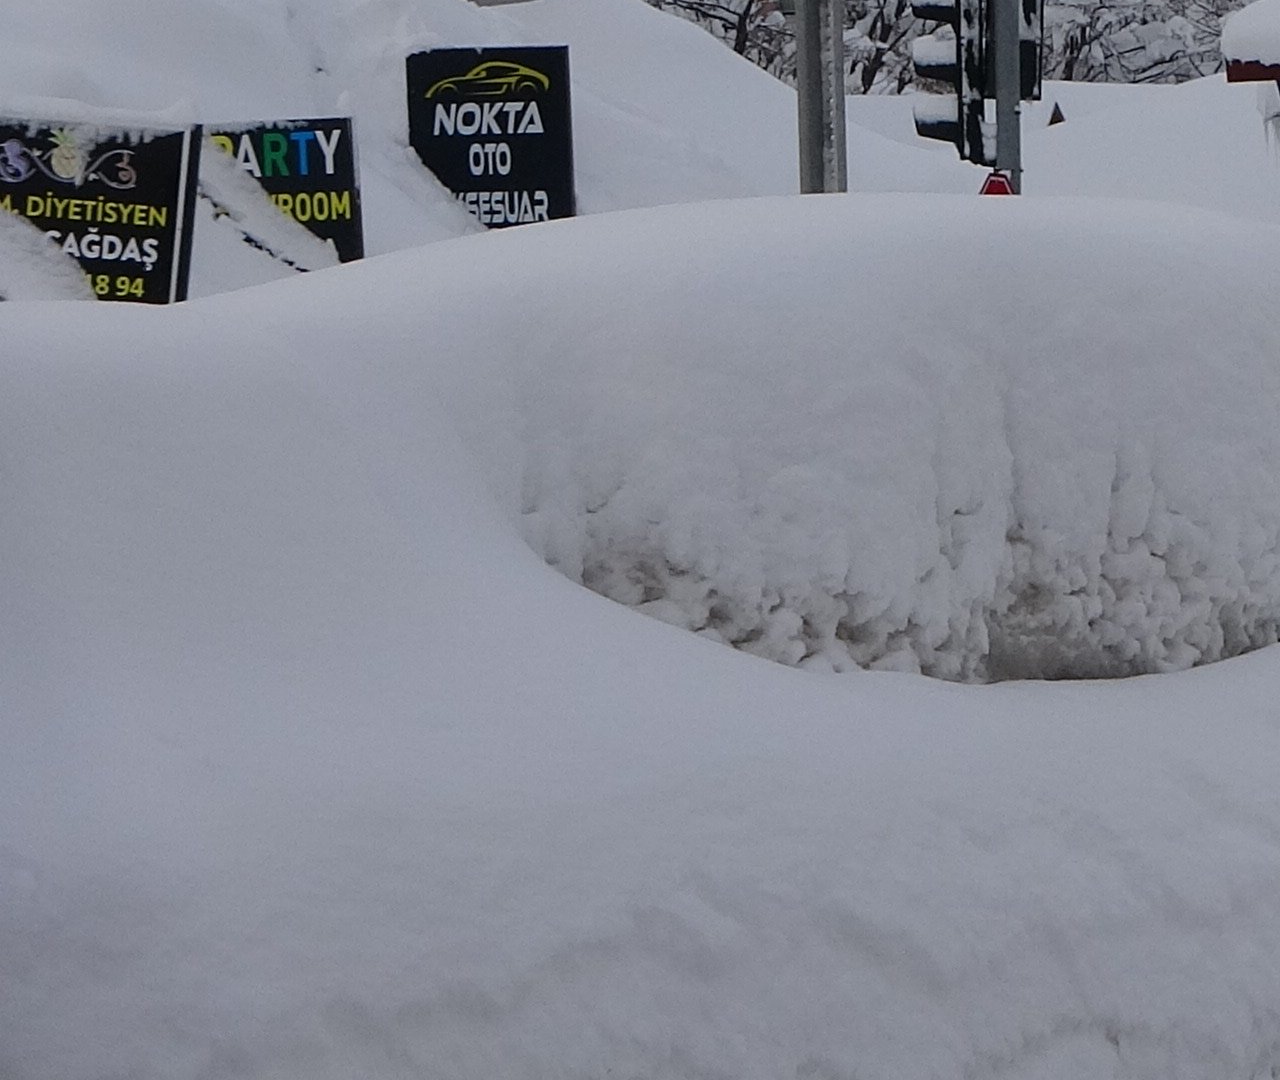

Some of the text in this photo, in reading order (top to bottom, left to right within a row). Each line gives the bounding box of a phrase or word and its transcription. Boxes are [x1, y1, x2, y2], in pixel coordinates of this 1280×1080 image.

[433, 101, 545, 136] NOKTA
[469, 142, 512, 176] OTO
[26, 191, 168, 228] DİYETİSYEN
[270, 190, 351, 222] ROOM
[453, 190, 550, 224] SESUAR
[115, 276, 145, 298] 94
